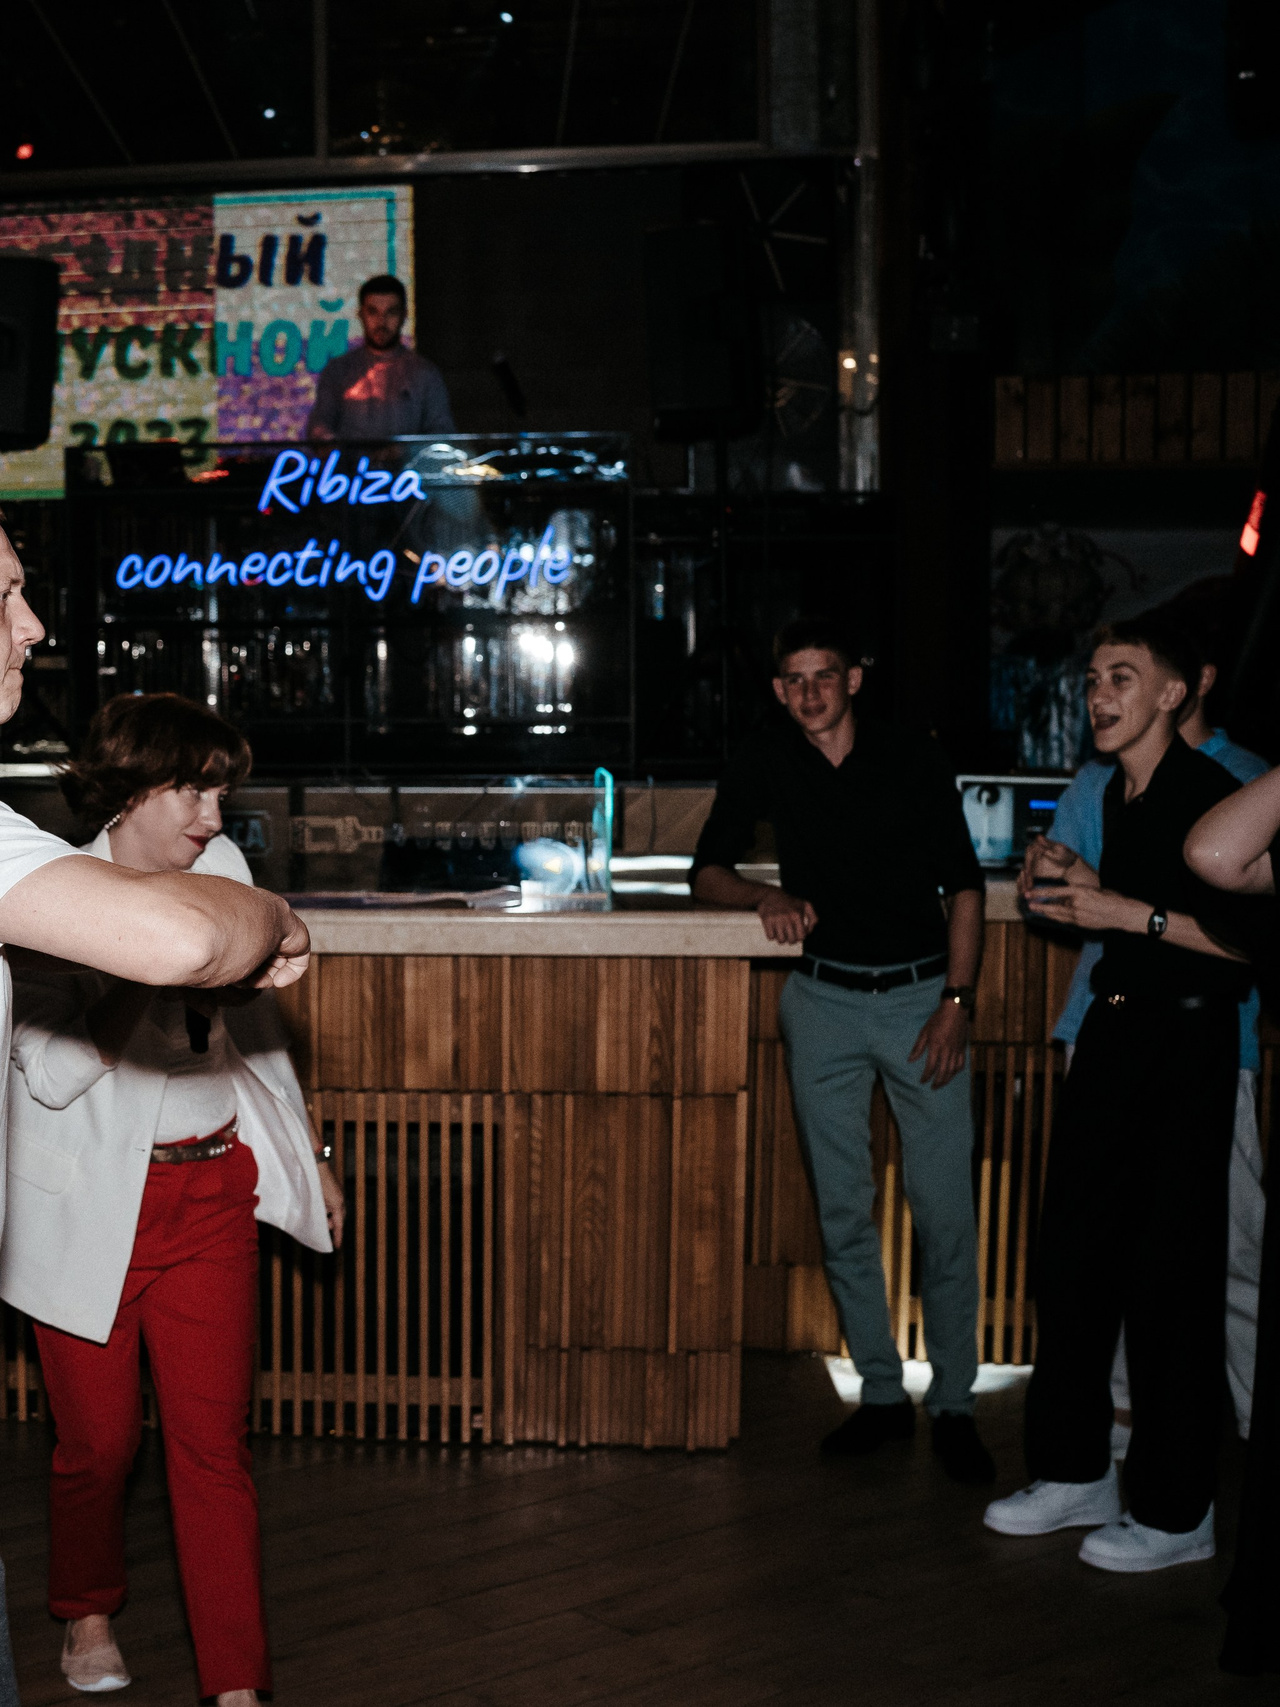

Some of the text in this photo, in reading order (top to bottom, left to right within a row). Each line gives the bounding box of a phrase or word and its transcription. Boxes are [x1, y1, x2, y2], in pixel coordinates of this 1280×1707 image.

[257, 448, 428, 515] Ribiza
[115, 524, 572, 604] connecting people
